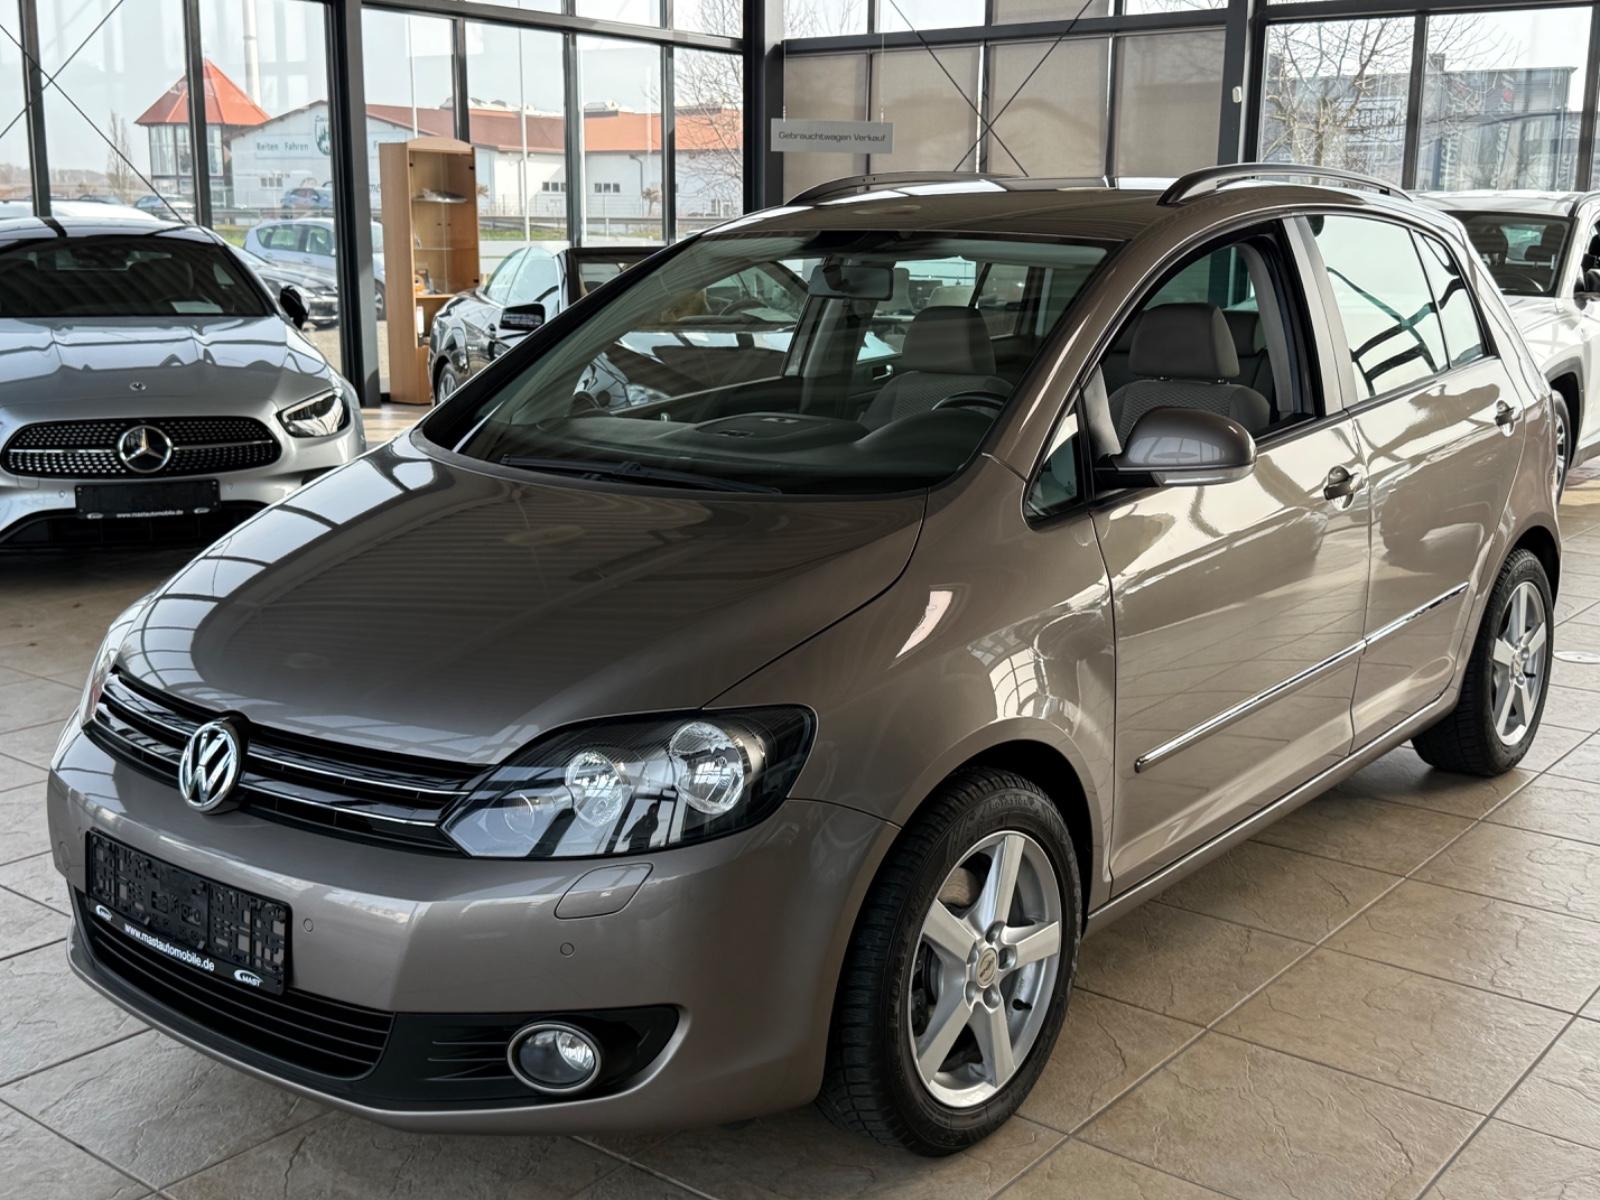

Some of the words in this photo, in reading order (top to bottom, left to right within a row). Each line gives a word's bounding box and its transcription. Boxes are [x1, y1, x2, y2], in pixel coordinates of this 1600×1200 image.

[778, 131, 851, 142] Gebrauchtwagen
[854, 133, 886, 142] Verkauf
[256, 142, 279, 151] Reiten
[284, 142, 309, 151] Fahren
[124, 923, 215, 972] www.mastautomobile.de
